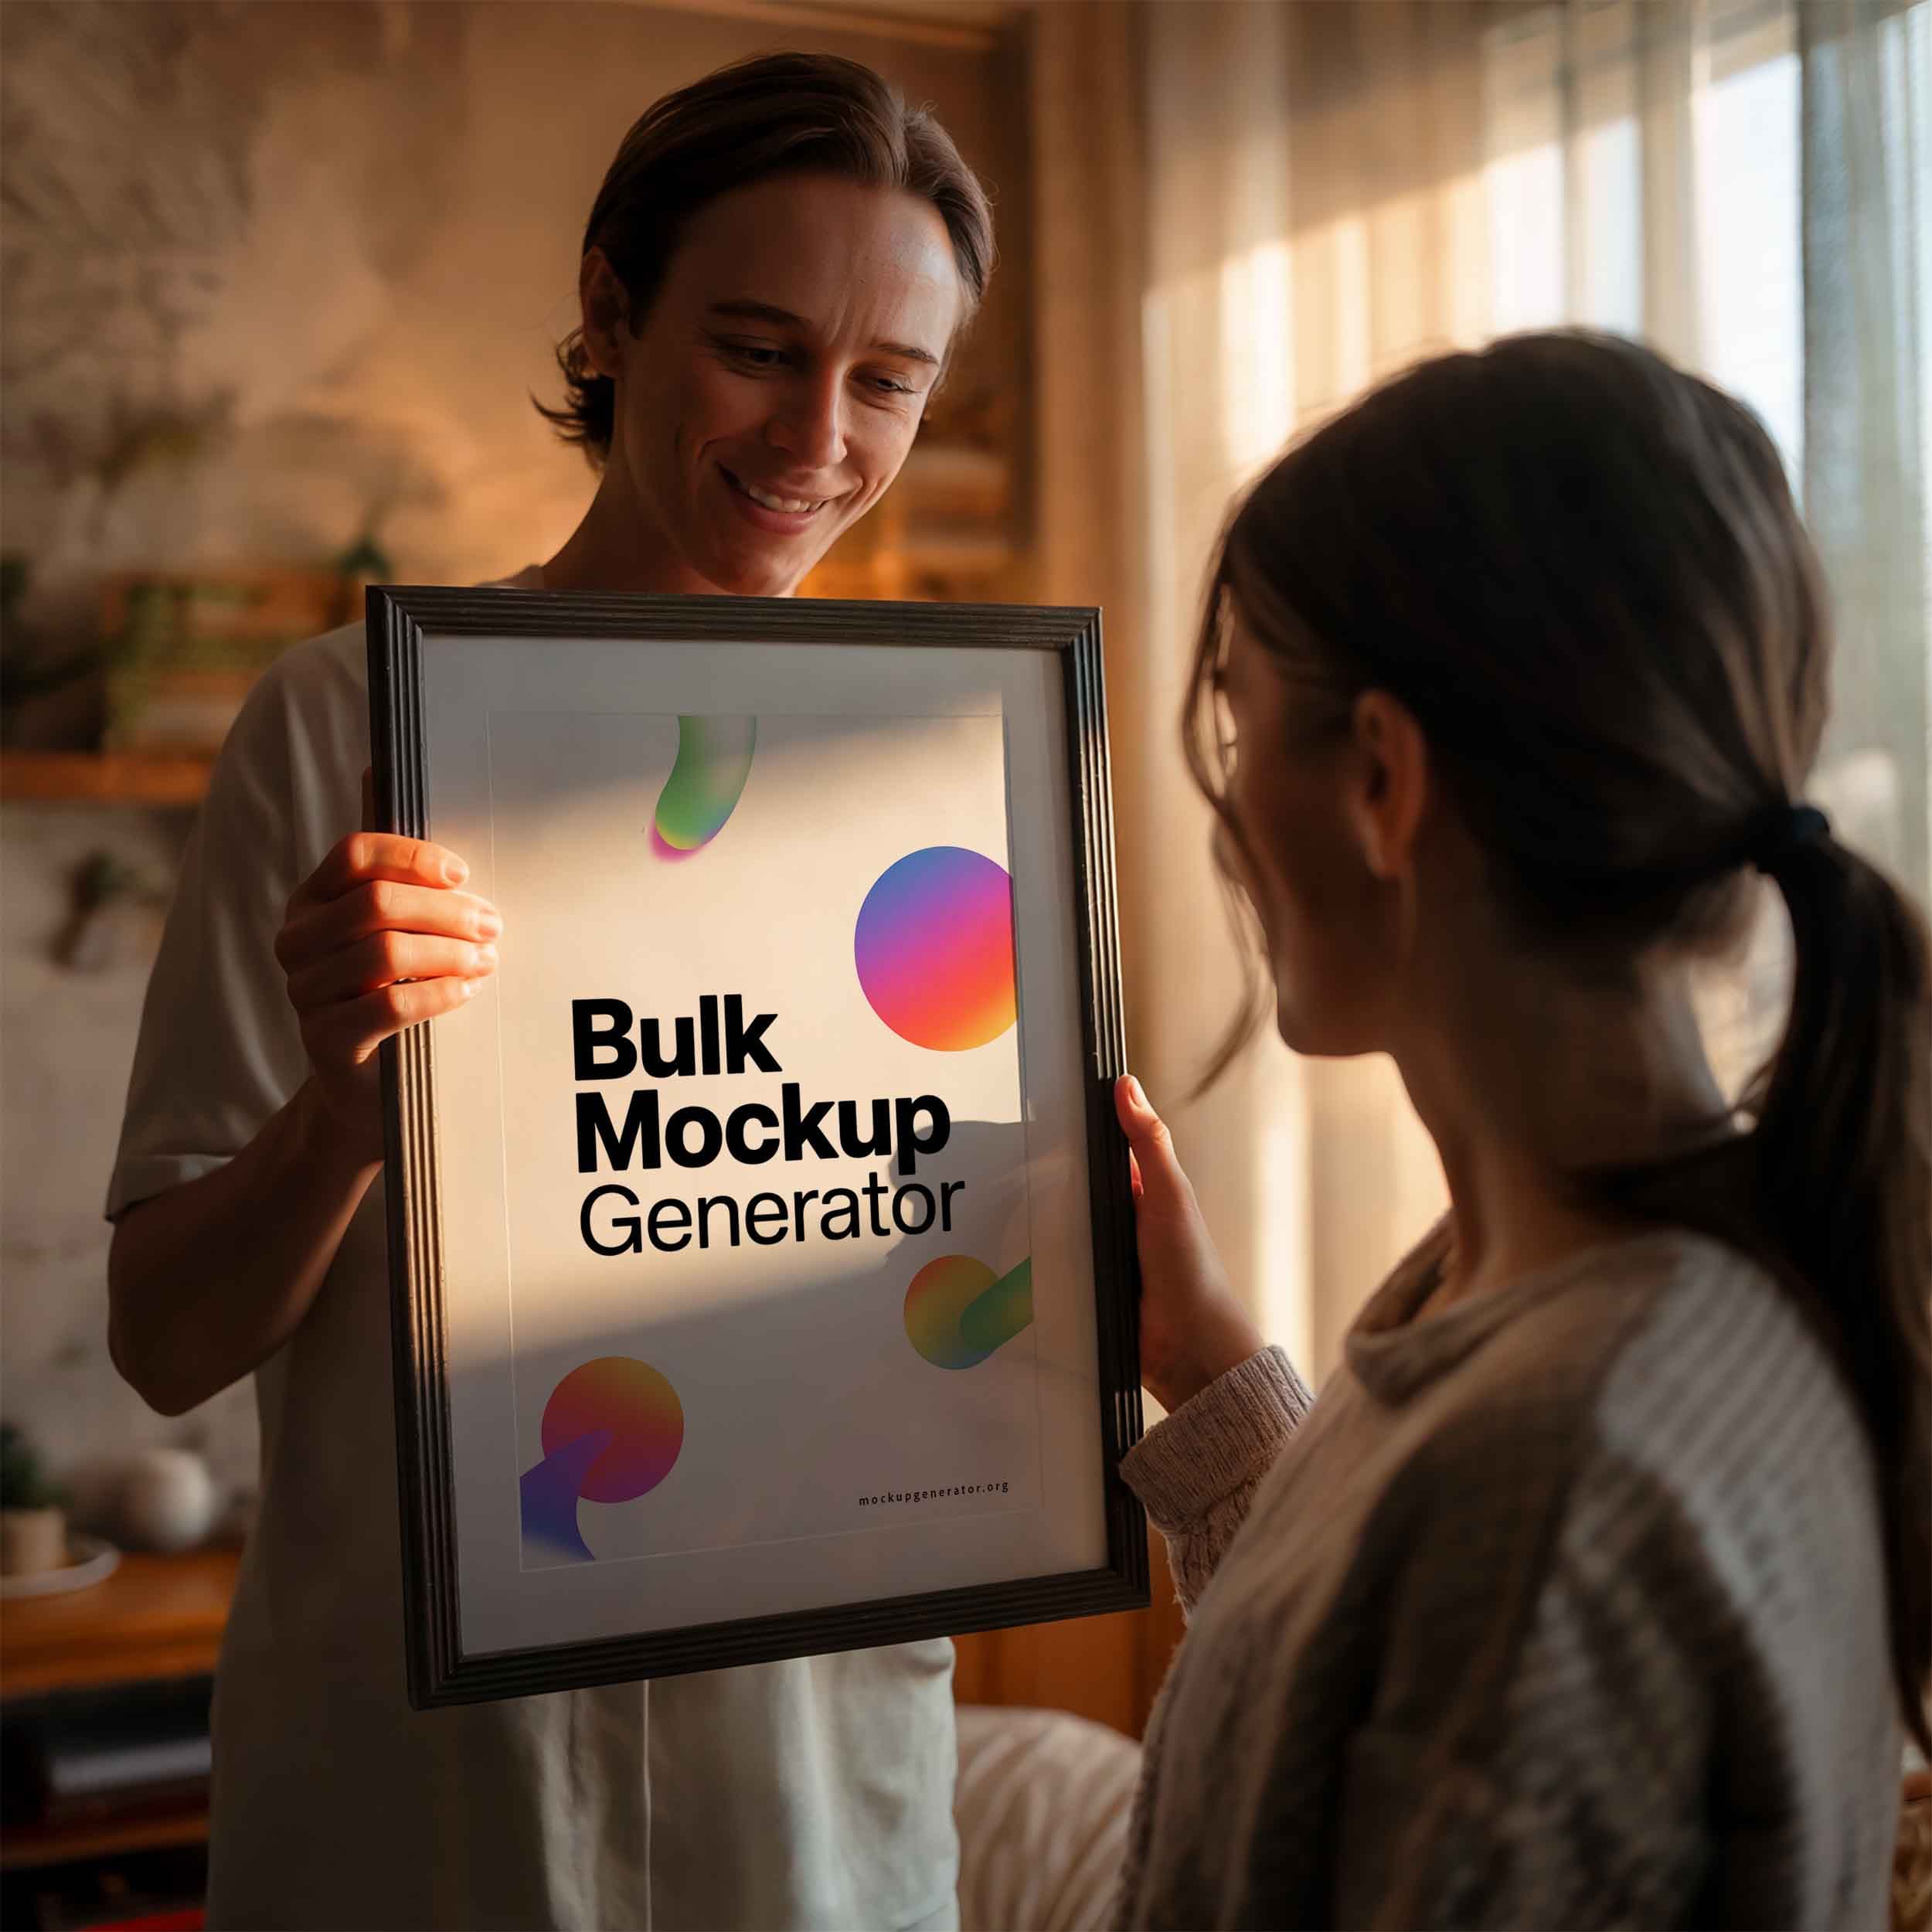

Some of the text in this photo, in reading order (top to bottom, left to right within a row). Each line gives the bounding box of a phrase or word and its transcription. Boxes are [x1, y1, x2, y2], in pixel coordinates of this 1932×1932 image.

[571, 994, 783, 1082] Bulk
[576, 1083, 951, 1177] Mockup
[580, 1171, 966, 1257] Generator
[859, 1481, 1009, 1506] mockupgenerator.org
